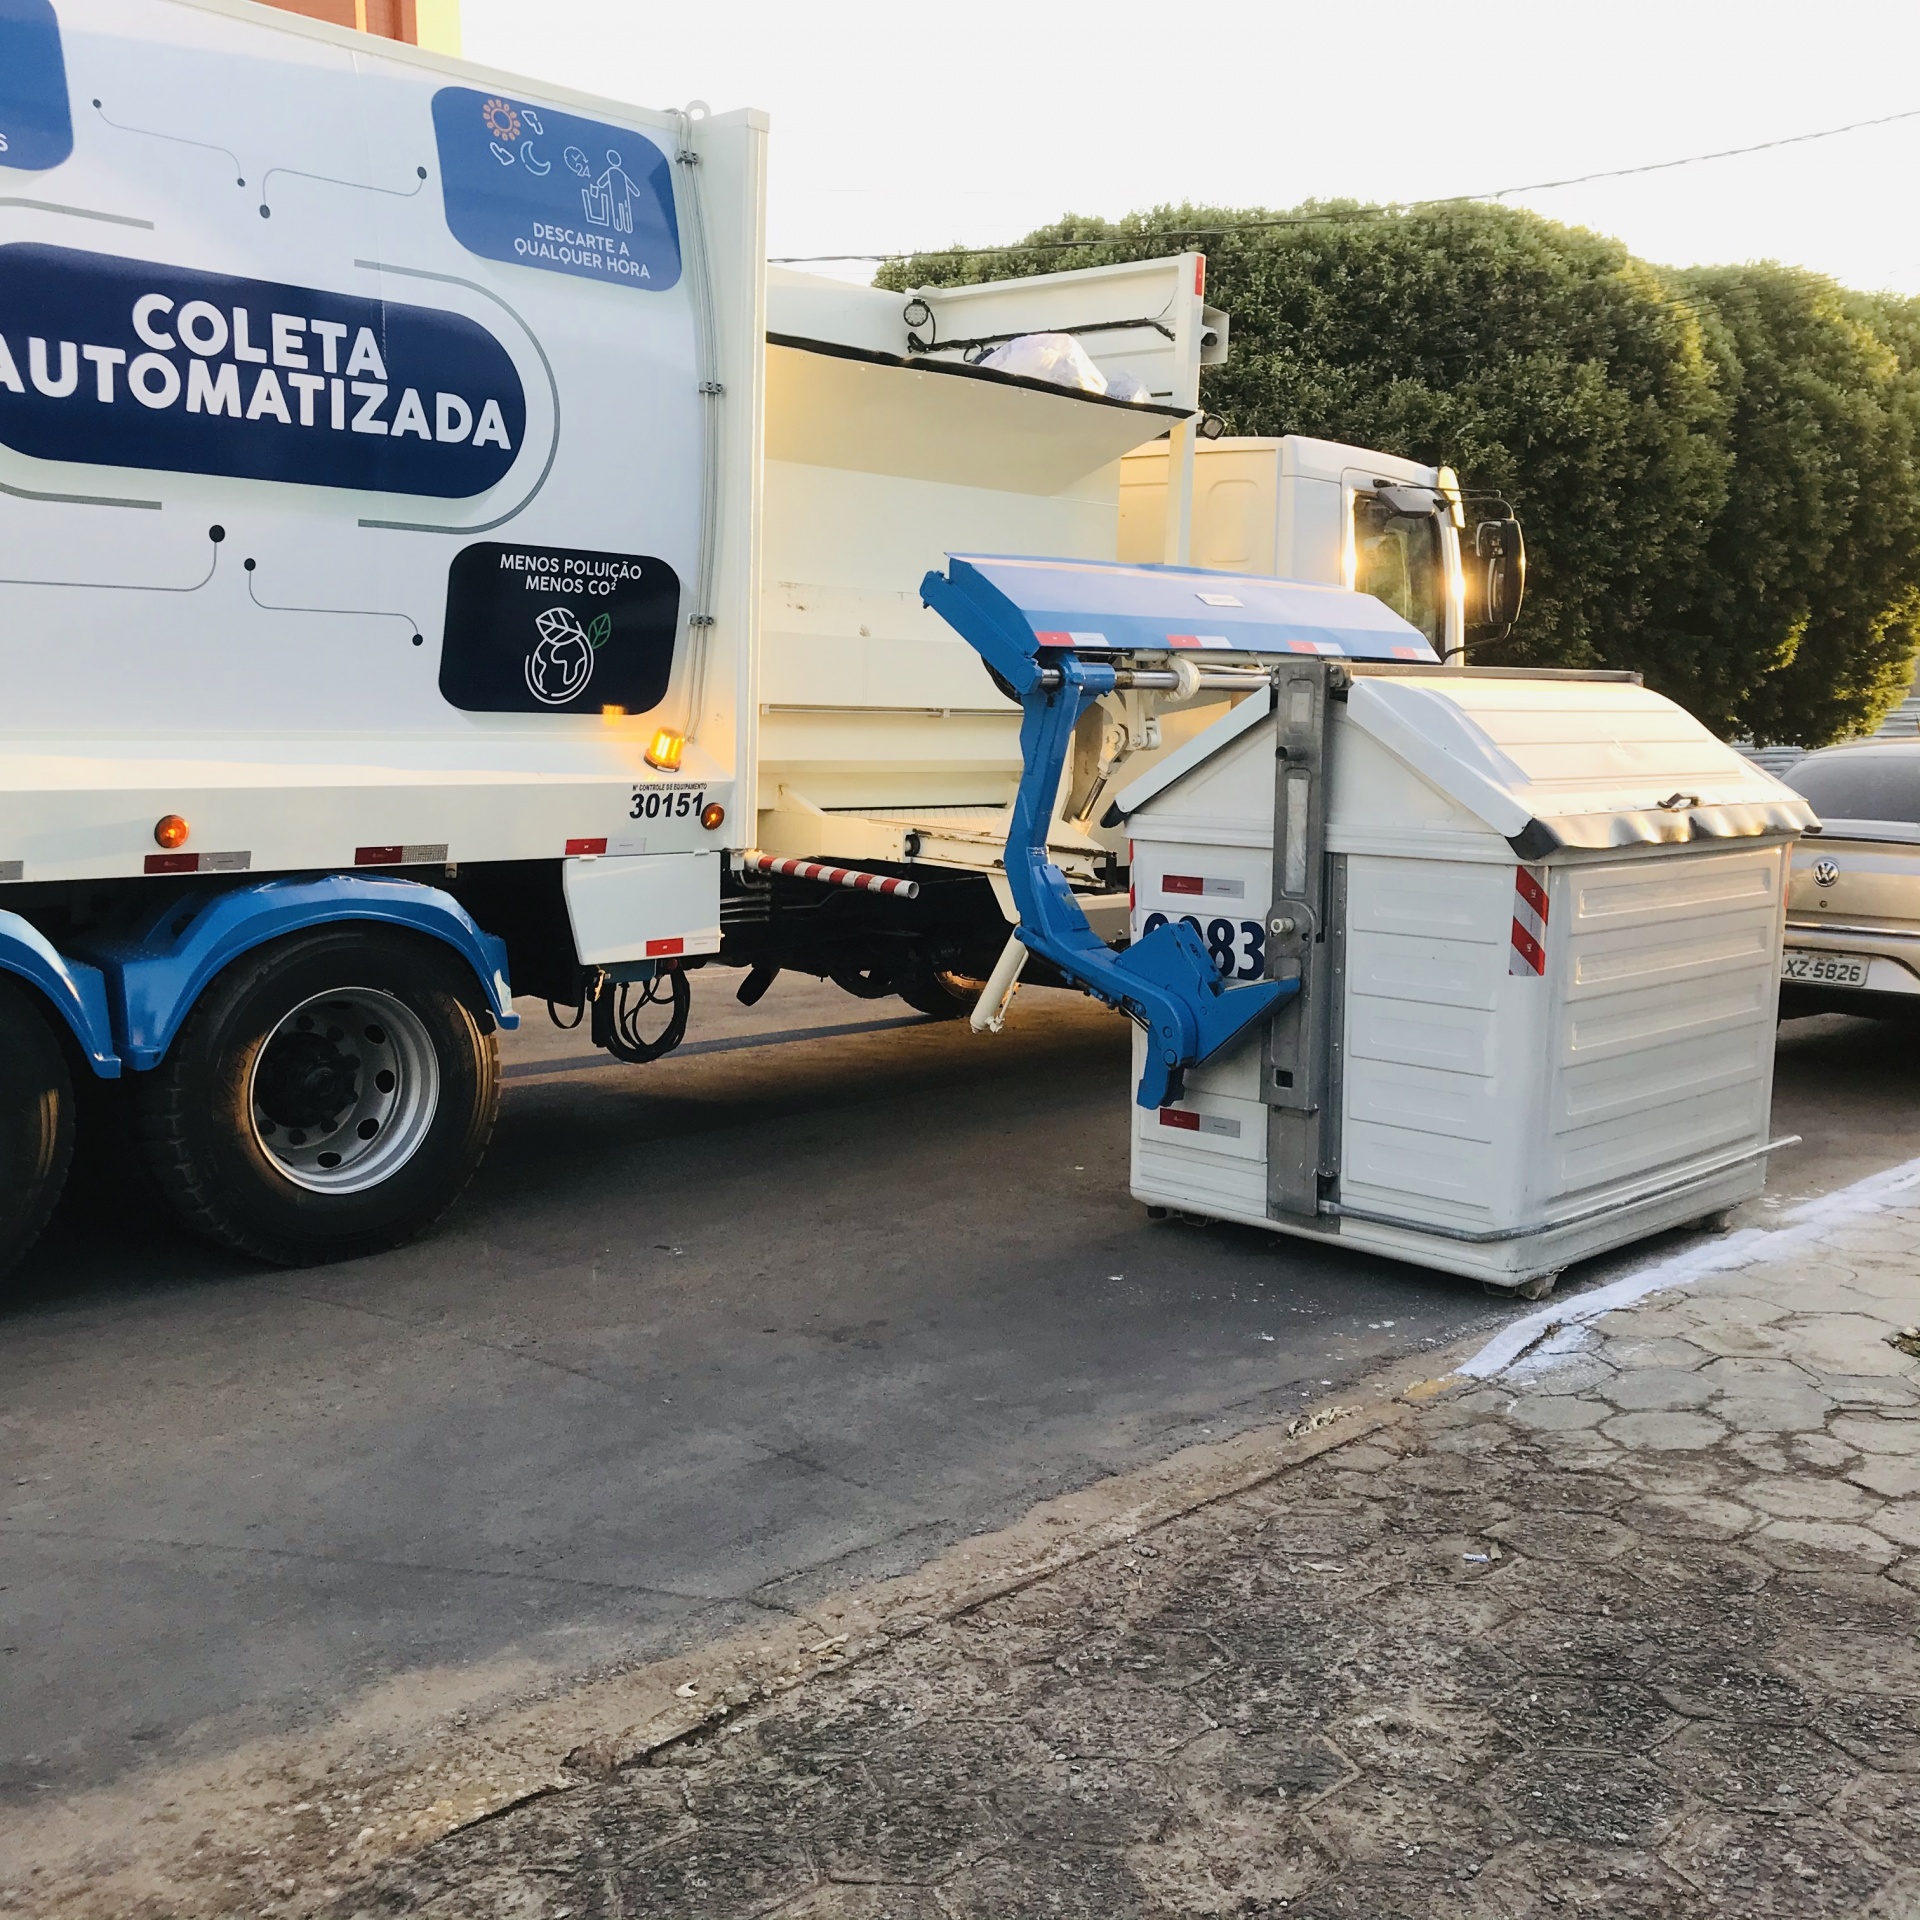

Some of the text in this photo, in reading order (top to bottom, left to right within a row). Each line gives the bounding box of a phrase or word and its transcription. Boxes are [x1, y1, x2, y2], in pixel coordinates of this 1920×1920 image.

[533, 222, 630, 257] DESCARTE A
[514, 238, 651, 279] QUALQUER HORA
[132, 293, 389, 380] COLETA
[500, 554, 642, 582] MENOS POLUIÇÃO
[525, 575, 584, 593] MENOS
[639, 783, 665, 791] CONTROLE
[673, 782, 708, 790] EQUIPAMENTO
[629, 791, 704, 819] 30151
